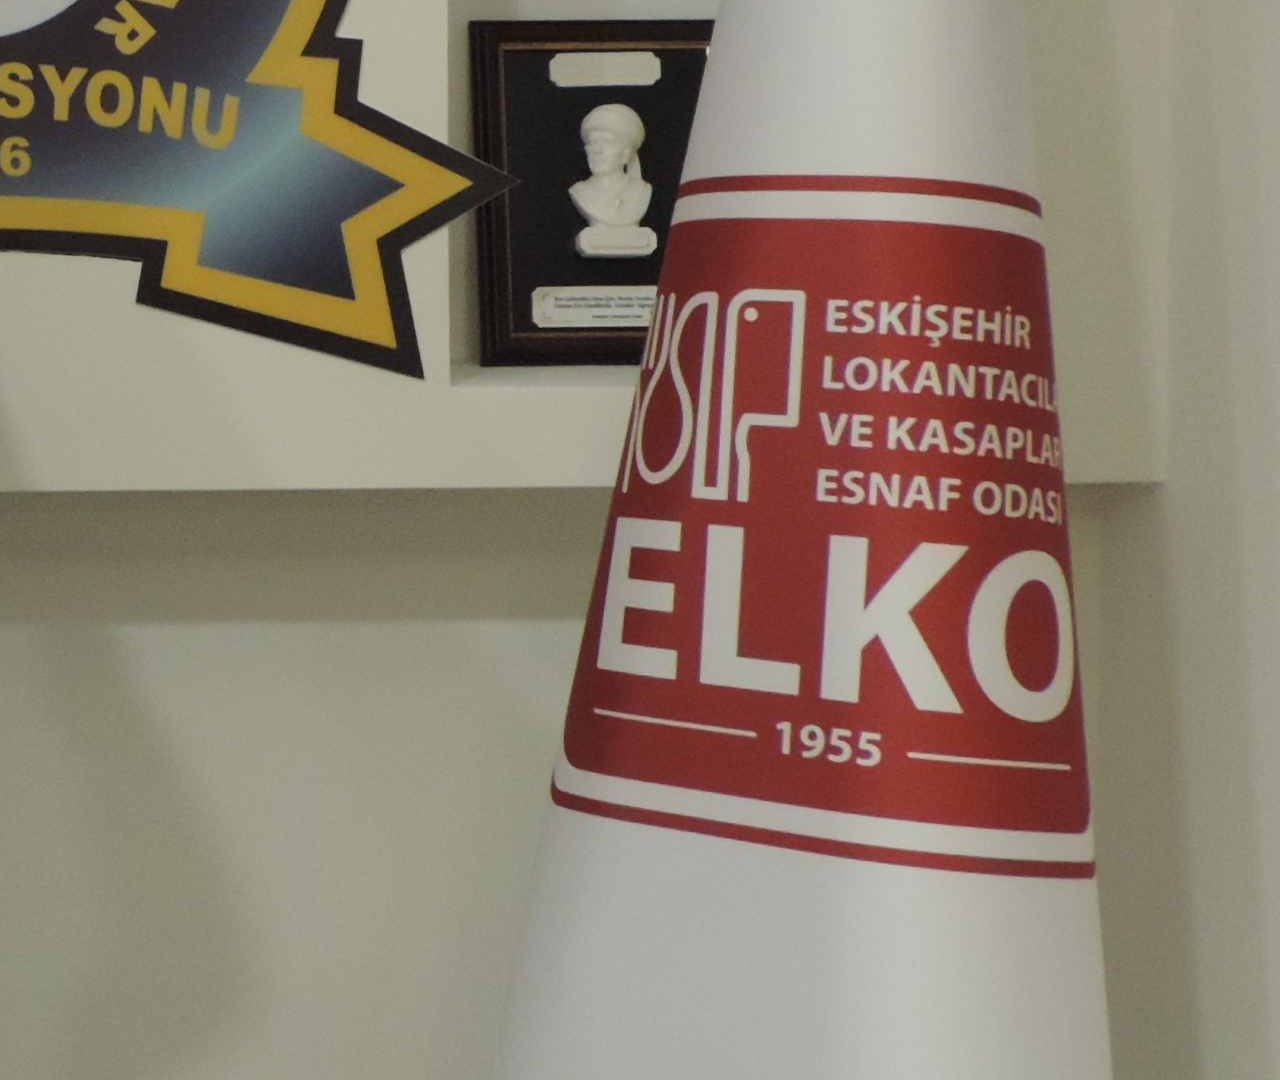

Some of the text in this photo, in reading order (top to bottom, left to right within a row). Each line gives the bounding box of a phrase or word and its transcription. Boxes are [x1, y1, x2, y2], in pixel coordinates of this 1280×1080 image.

[825, 294, 1031, 349] ESKİŞEHİR
[821, 355, 1057, 412] LOKANTACIL
[819, 412, 875, 448] VE
[815, 468, 1063, 526] ESNAF ODASI
[596, 517, 1074, 723] ELKO
[775, 720, 883, 767] 1955
